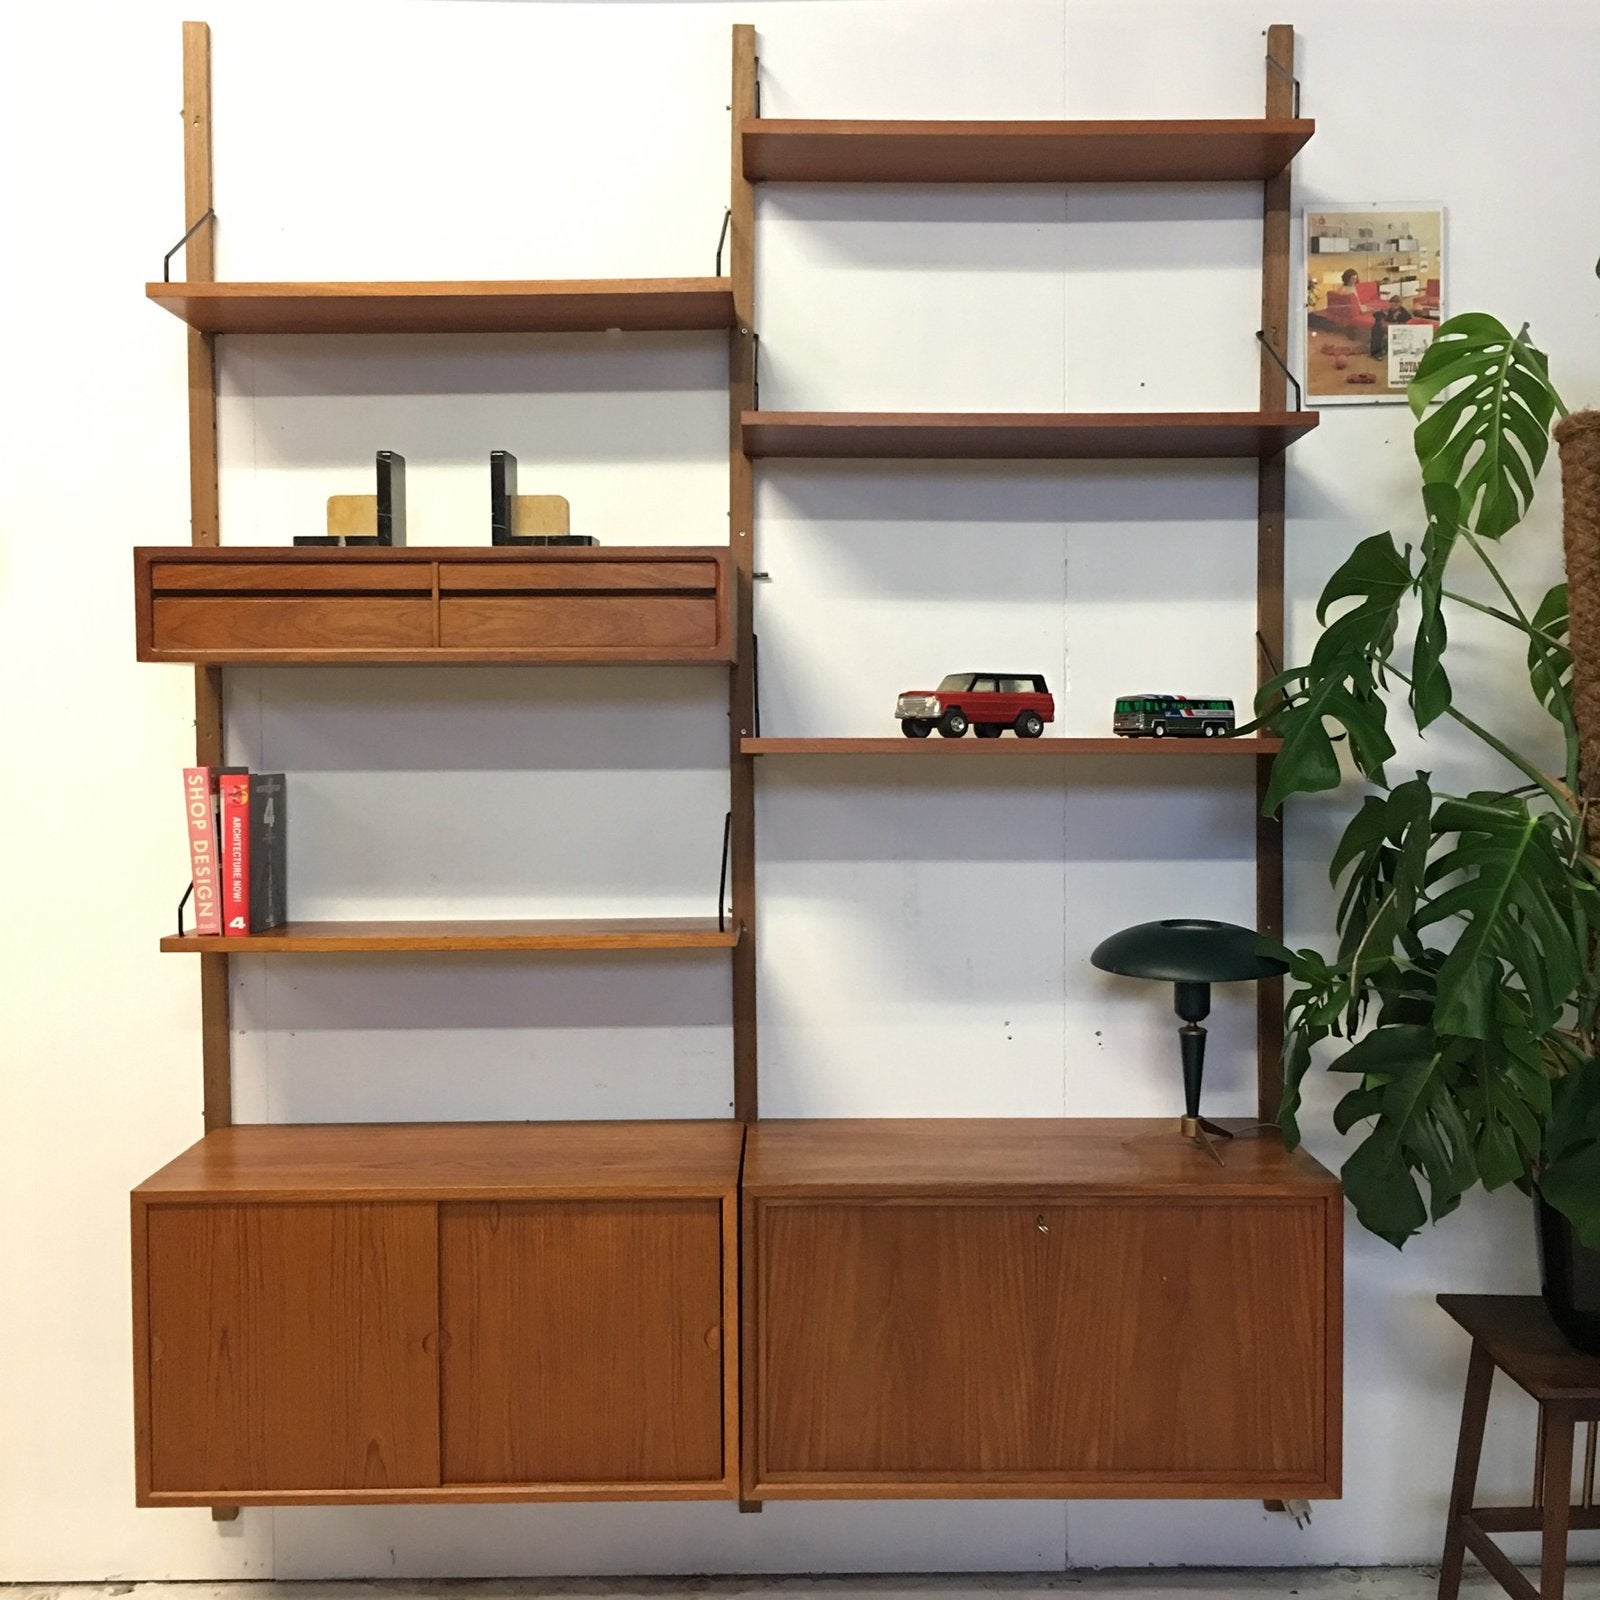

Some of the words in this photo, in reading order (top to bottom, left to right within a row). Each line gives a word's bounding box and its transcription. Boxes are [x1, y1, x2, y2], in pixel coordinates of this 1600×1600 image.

[1399, 361, 1420, 372] ROYA
[188, 774, 207, 830] SHOP
[232, 816, 243, 879] ARCHITECTURE
[193, 840, 214, 917] DESIGN
[229, 916, 247, 930] 4
